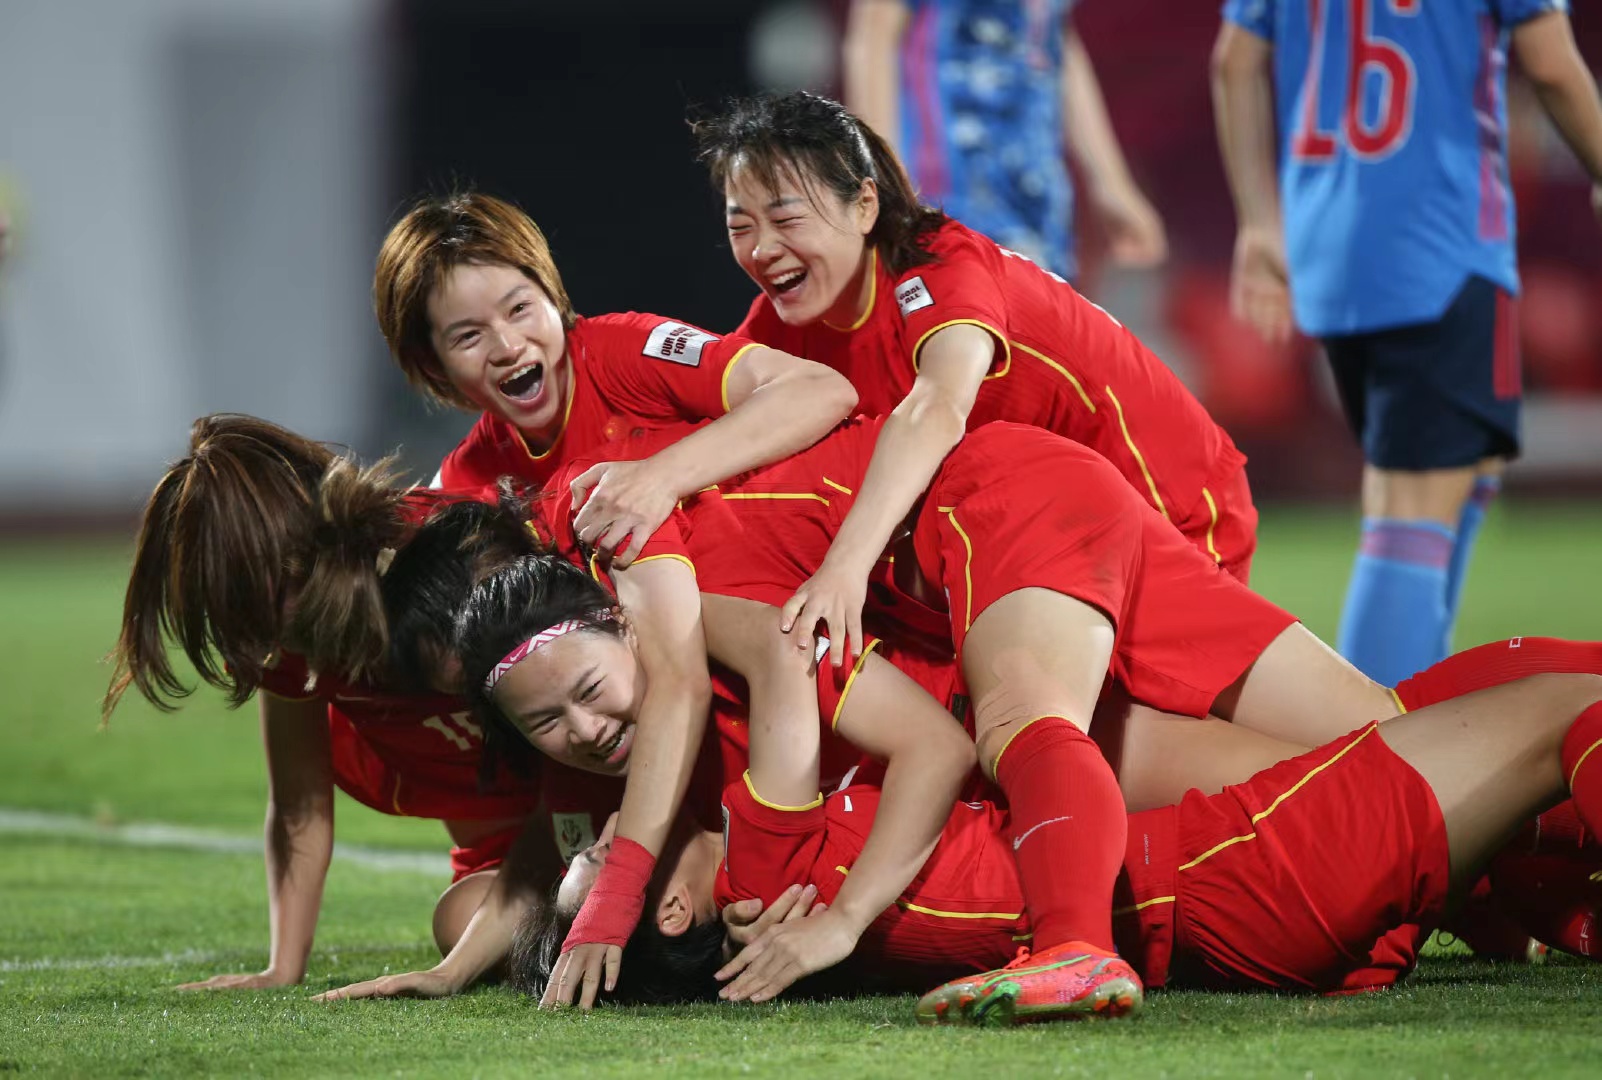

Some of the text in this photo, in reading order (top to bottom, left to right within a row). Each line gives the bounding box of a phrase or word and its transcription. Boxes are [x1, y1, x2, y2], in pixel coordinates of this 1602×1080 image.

[1291, 0, 1418, 164] 16
[661, 337, 675, 356] OUR
[674, 337, 688, 354] FOR
